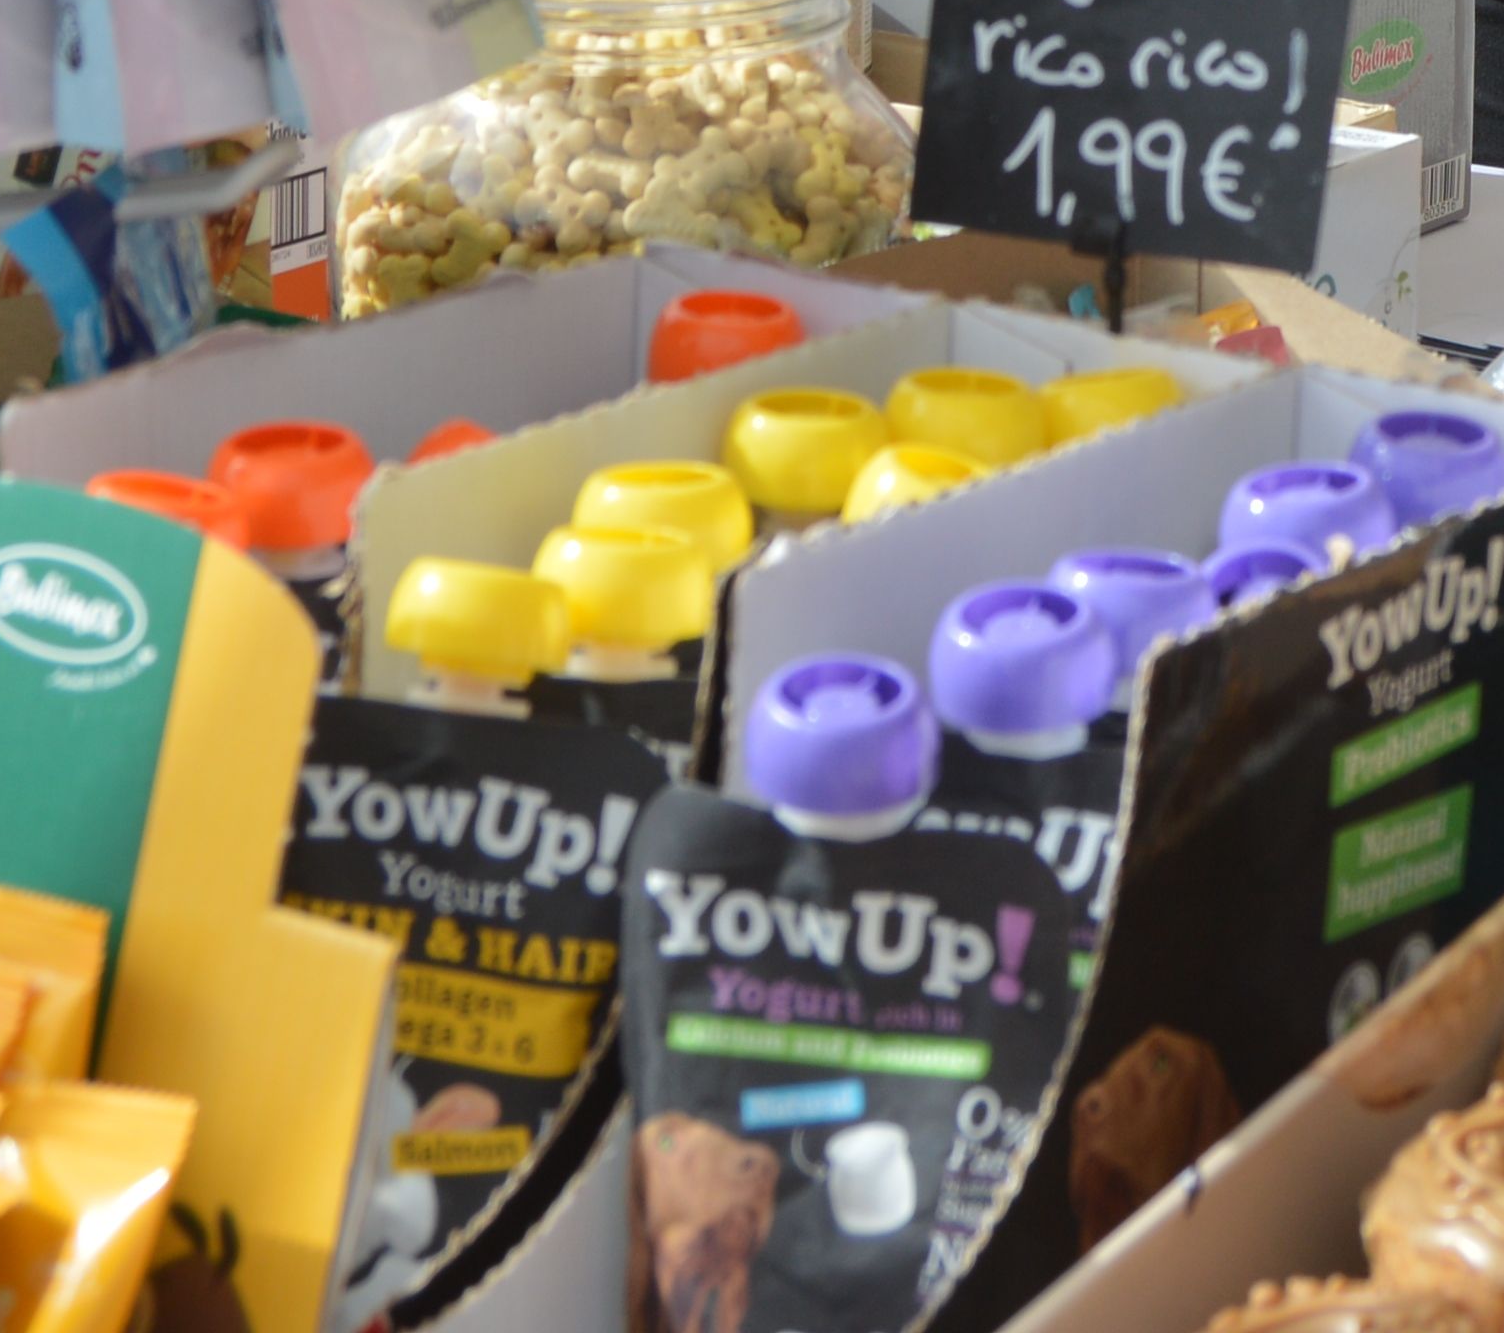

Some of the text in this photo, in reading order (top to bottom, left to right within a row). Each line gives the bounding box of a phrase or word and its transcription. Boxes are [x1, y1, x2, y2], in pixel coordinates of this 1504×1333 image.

[973, 12, 1105, 89] rico
[1349, 34, 1416, 87] Bubimex
[1002, 105, 1257, 227] 1,99€
[1366, 646, 1456, 718] Yogurt
[301, 763, 640, 896] YowUp!
[378, 848, 529, 922] Yogurt
[644, 867, 1038, 1008] YowUp!
[706, 963, 864, 1025] Yogurt
[750, 1089, 856, 1120] Natural
[399, 1136, 519, 1171] Salmon
